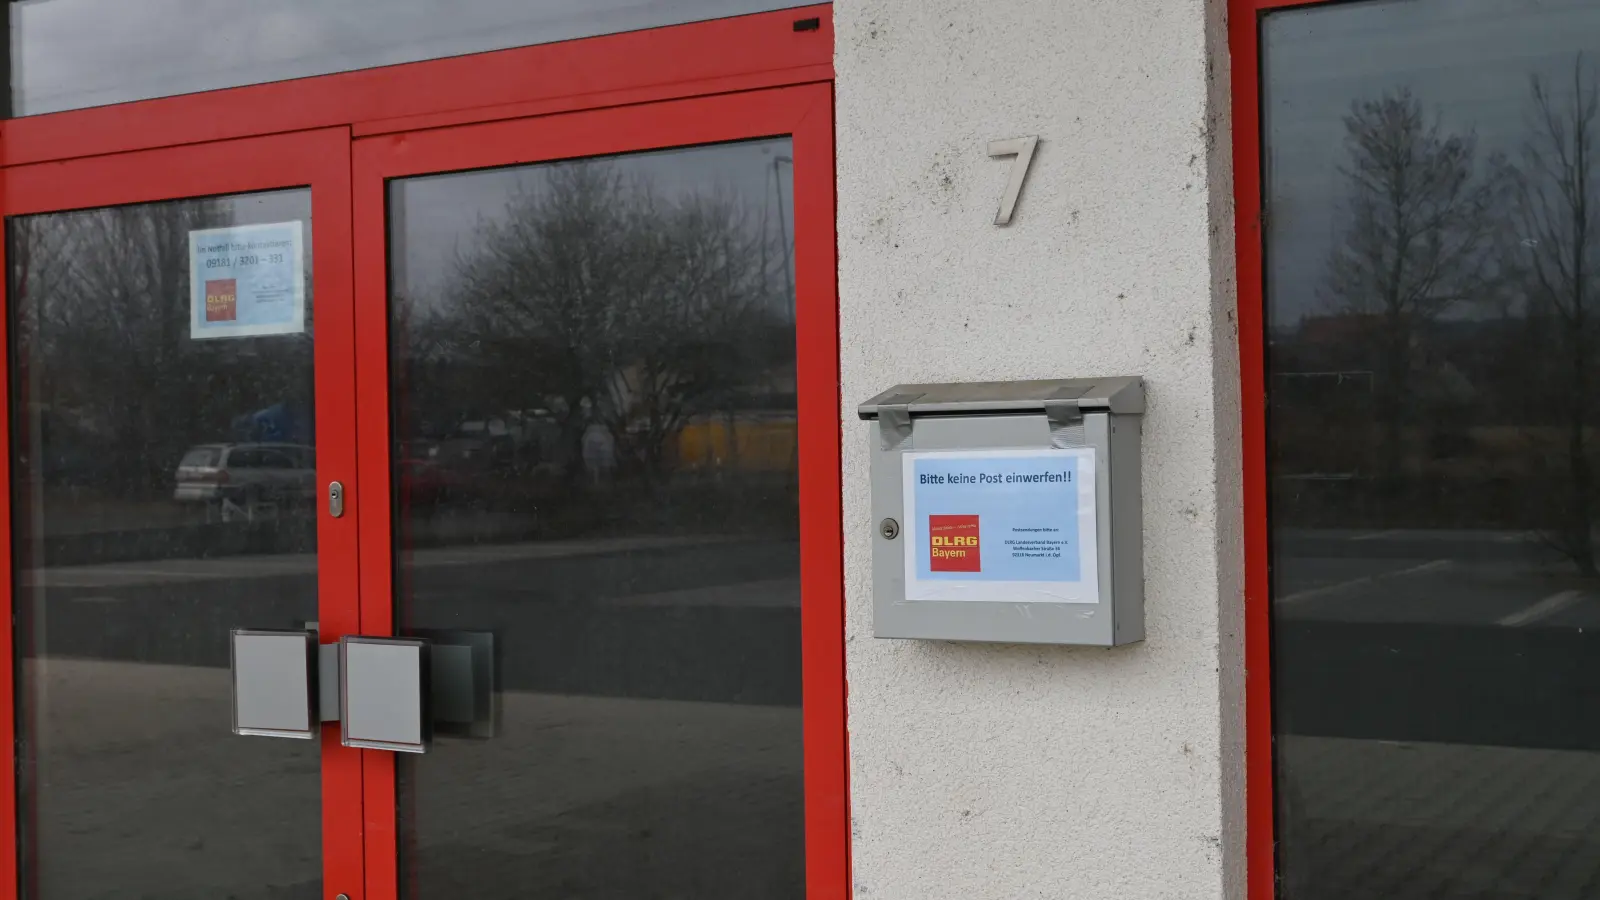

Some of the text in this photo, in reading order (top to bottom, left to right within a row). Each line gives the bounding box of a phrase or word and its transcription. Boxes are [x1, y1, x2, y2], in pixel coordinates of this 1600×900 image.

[986, 134, 1039, 226] 7
[206, 257, 231, 269] 09181
[920, 471, 1072, 485] Bitte keine Post einwerfen!!
[932, 536, 978, 546] DLRG
[932, 547, 966, 560] Bayern
